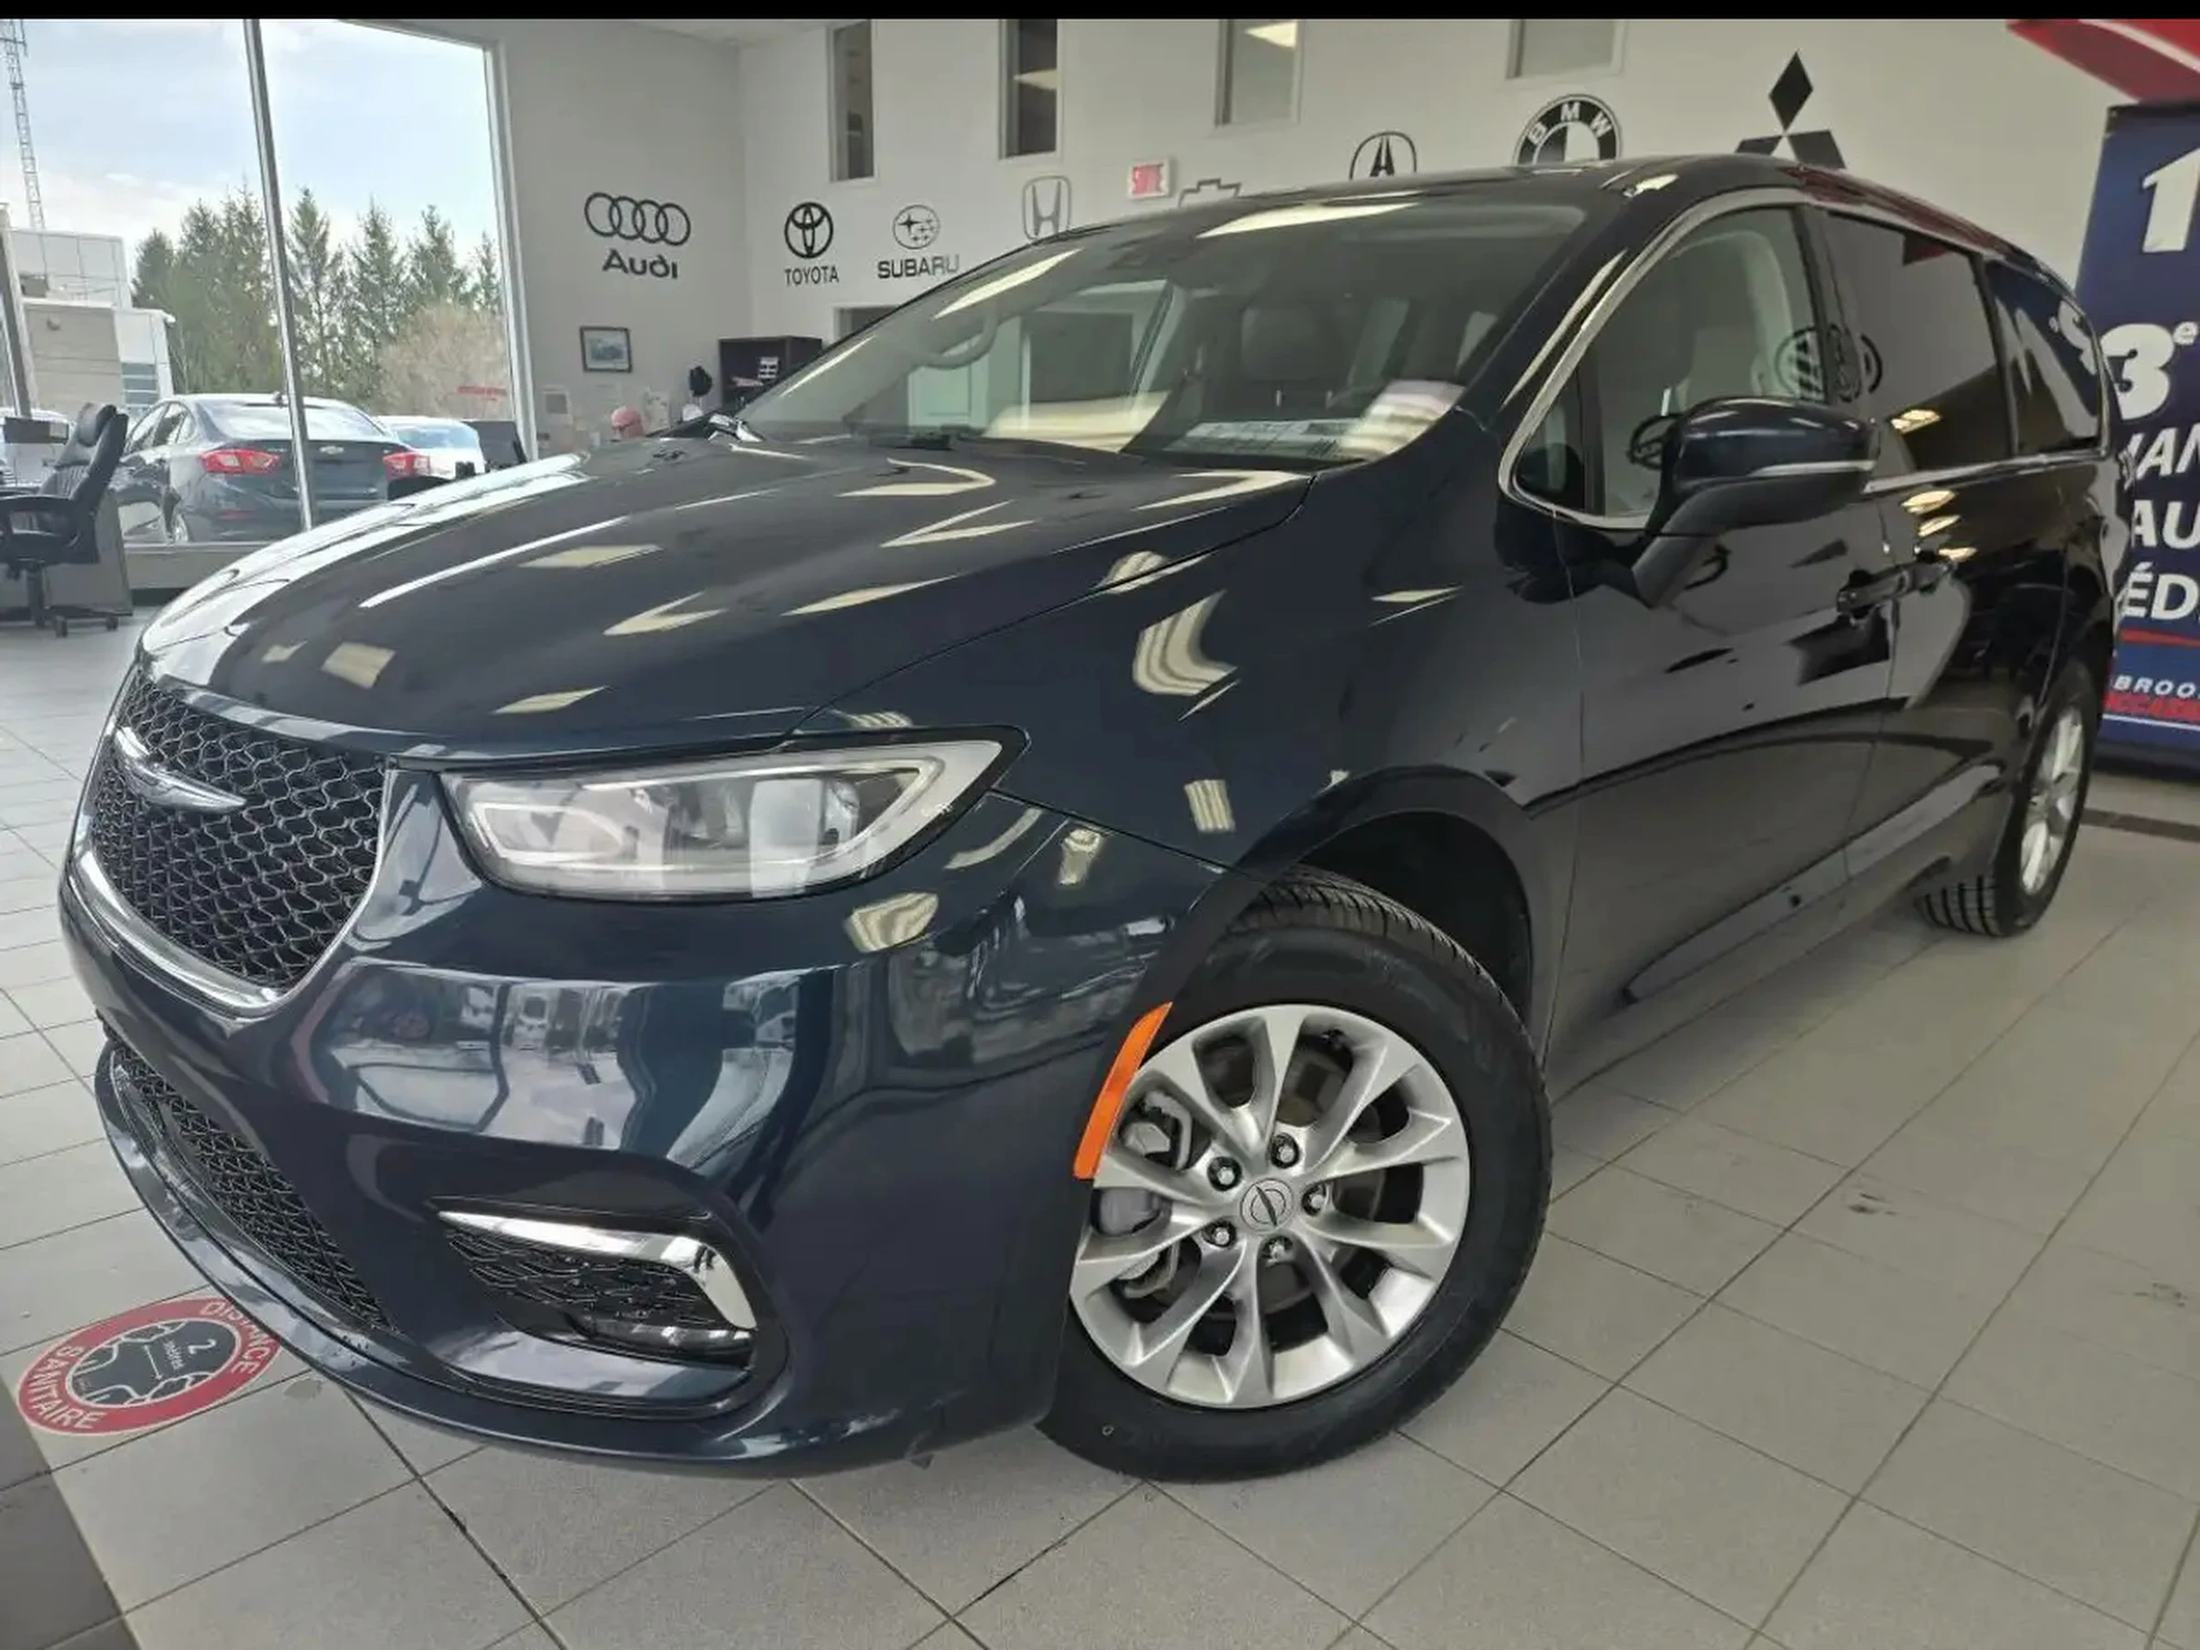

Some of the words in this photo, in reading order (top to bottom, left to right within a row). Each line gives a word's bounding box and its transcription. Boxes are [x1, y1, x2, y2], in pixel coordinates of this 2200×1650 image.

[1527, 101, 1613, 145] BMW
[602, 248, 678, 279] Audi
[784, 266, 840, 287] TOYOTA
[877, 254, 960, 280] SUBARU
[2131, 499, 2200, 550] AU
[2120, 561, 2200, 621] ÉD
[2113, 674, 2200, 698] BROO
[187, 1338, 217, 1355] 2
[29, 1345, 107, 1430] SANITAIRE
